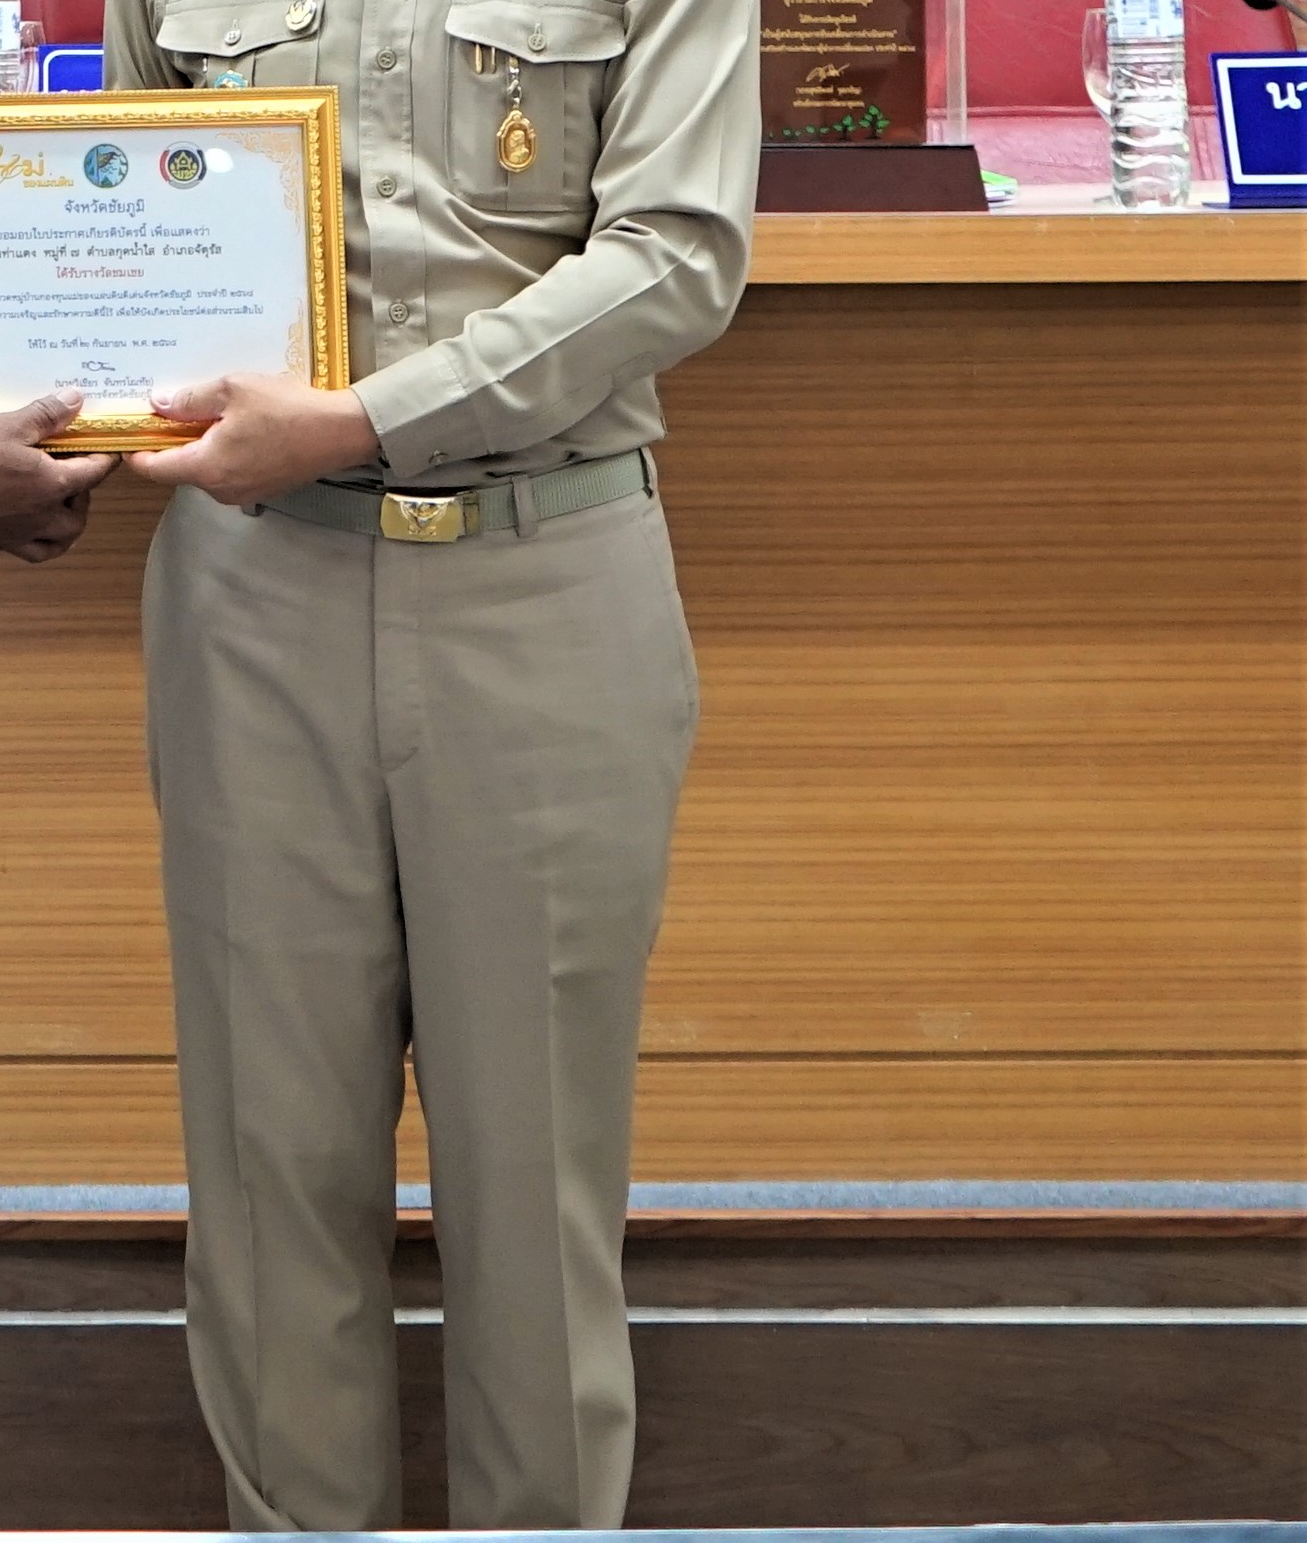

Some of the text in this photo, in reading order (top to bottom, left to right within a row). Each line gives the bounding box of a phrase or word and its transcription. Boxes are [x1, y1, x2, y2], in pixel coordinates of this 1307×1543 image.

[64, 198, 145, 218] จังหวัดชัยภูมิ
